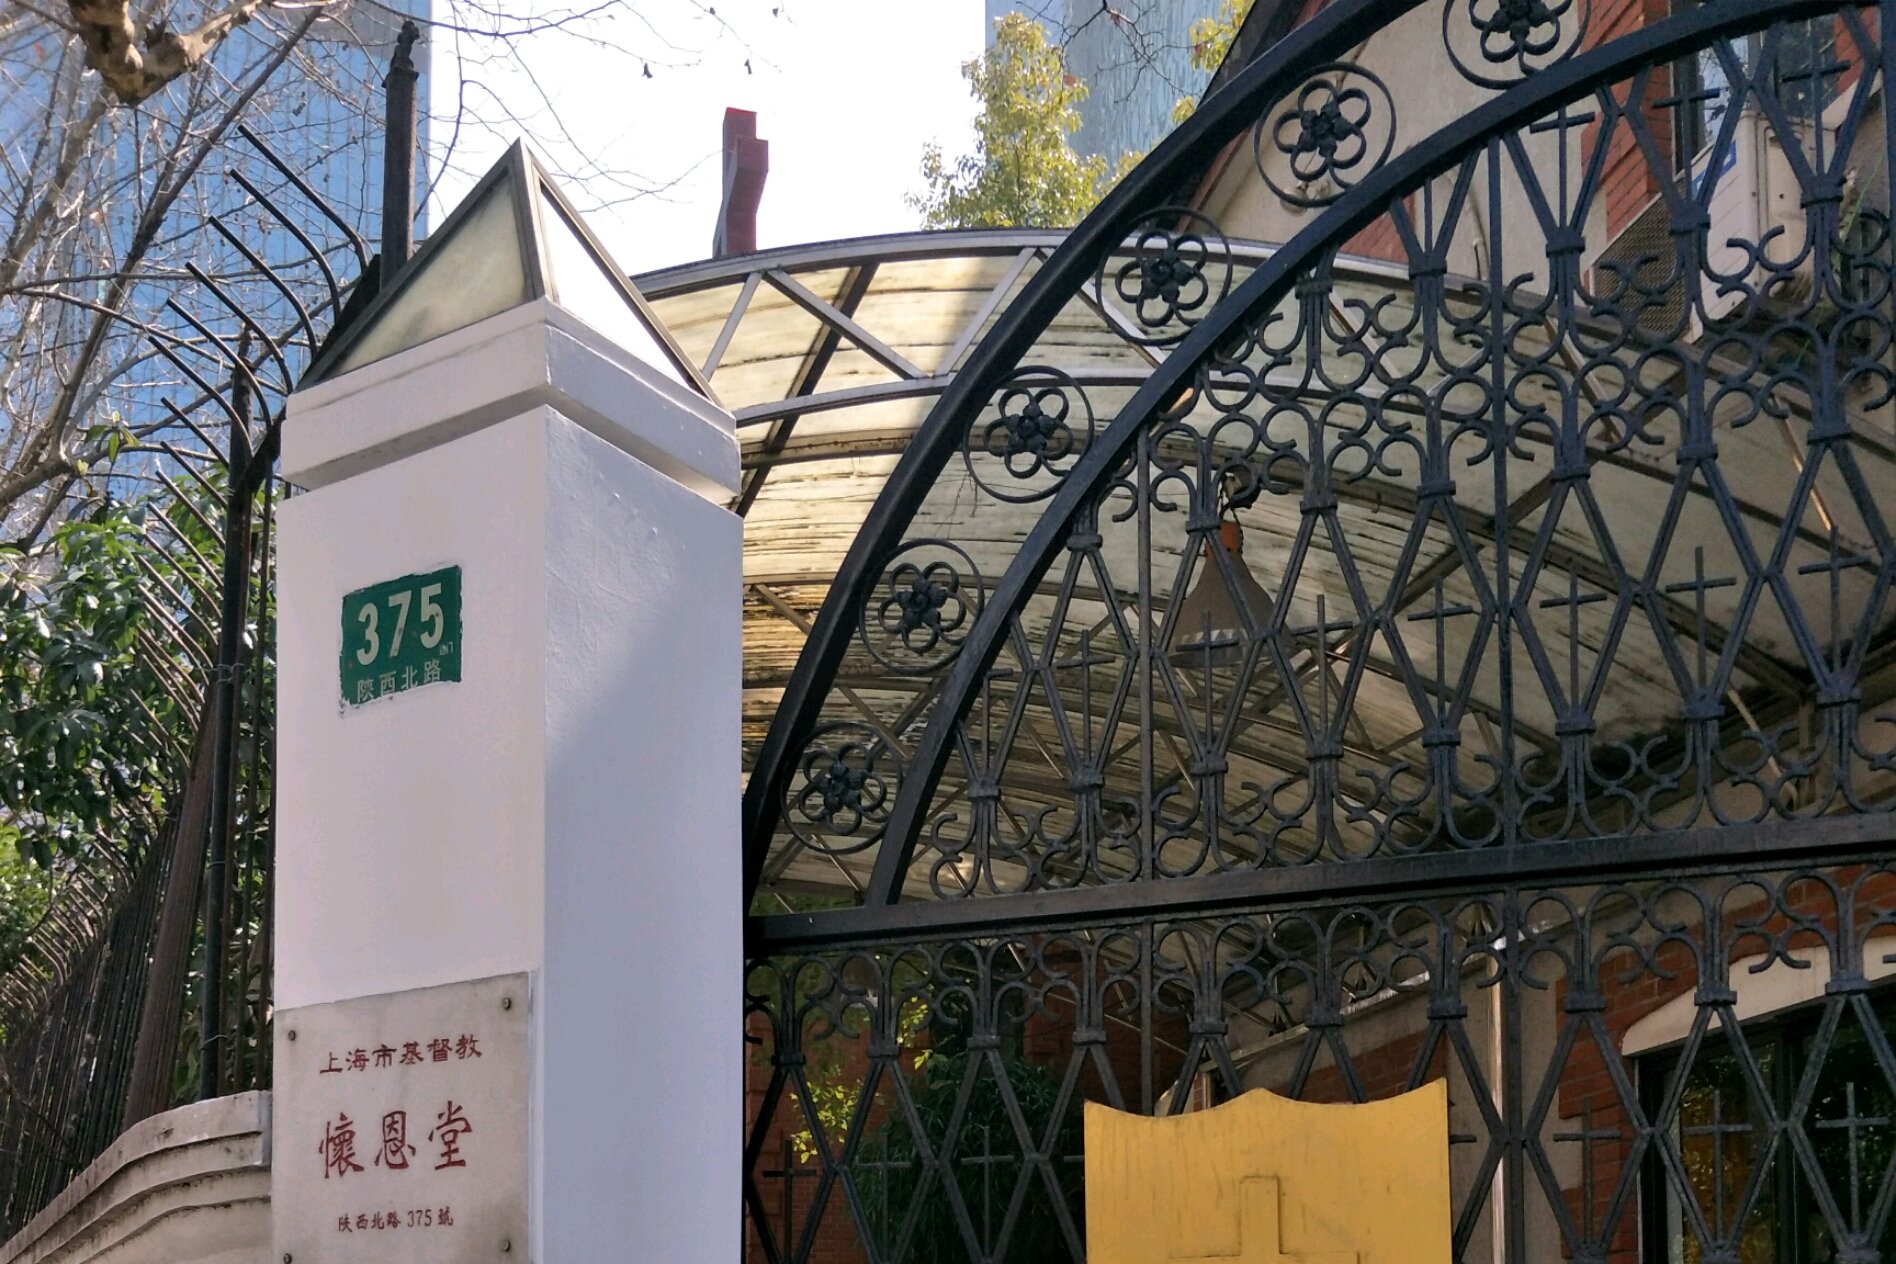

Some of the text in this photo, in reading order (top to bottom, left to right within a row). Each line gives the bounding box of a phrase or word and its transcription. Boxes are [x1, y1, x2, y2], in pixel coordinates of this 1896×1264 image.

[357, 583, 444, 666] 375
[357, 658, 442, 702] 陕西北路
[319, 1034, 483, 1074] 上海市基督教
[318, 1100, 473, 1179] 懷恩堂
